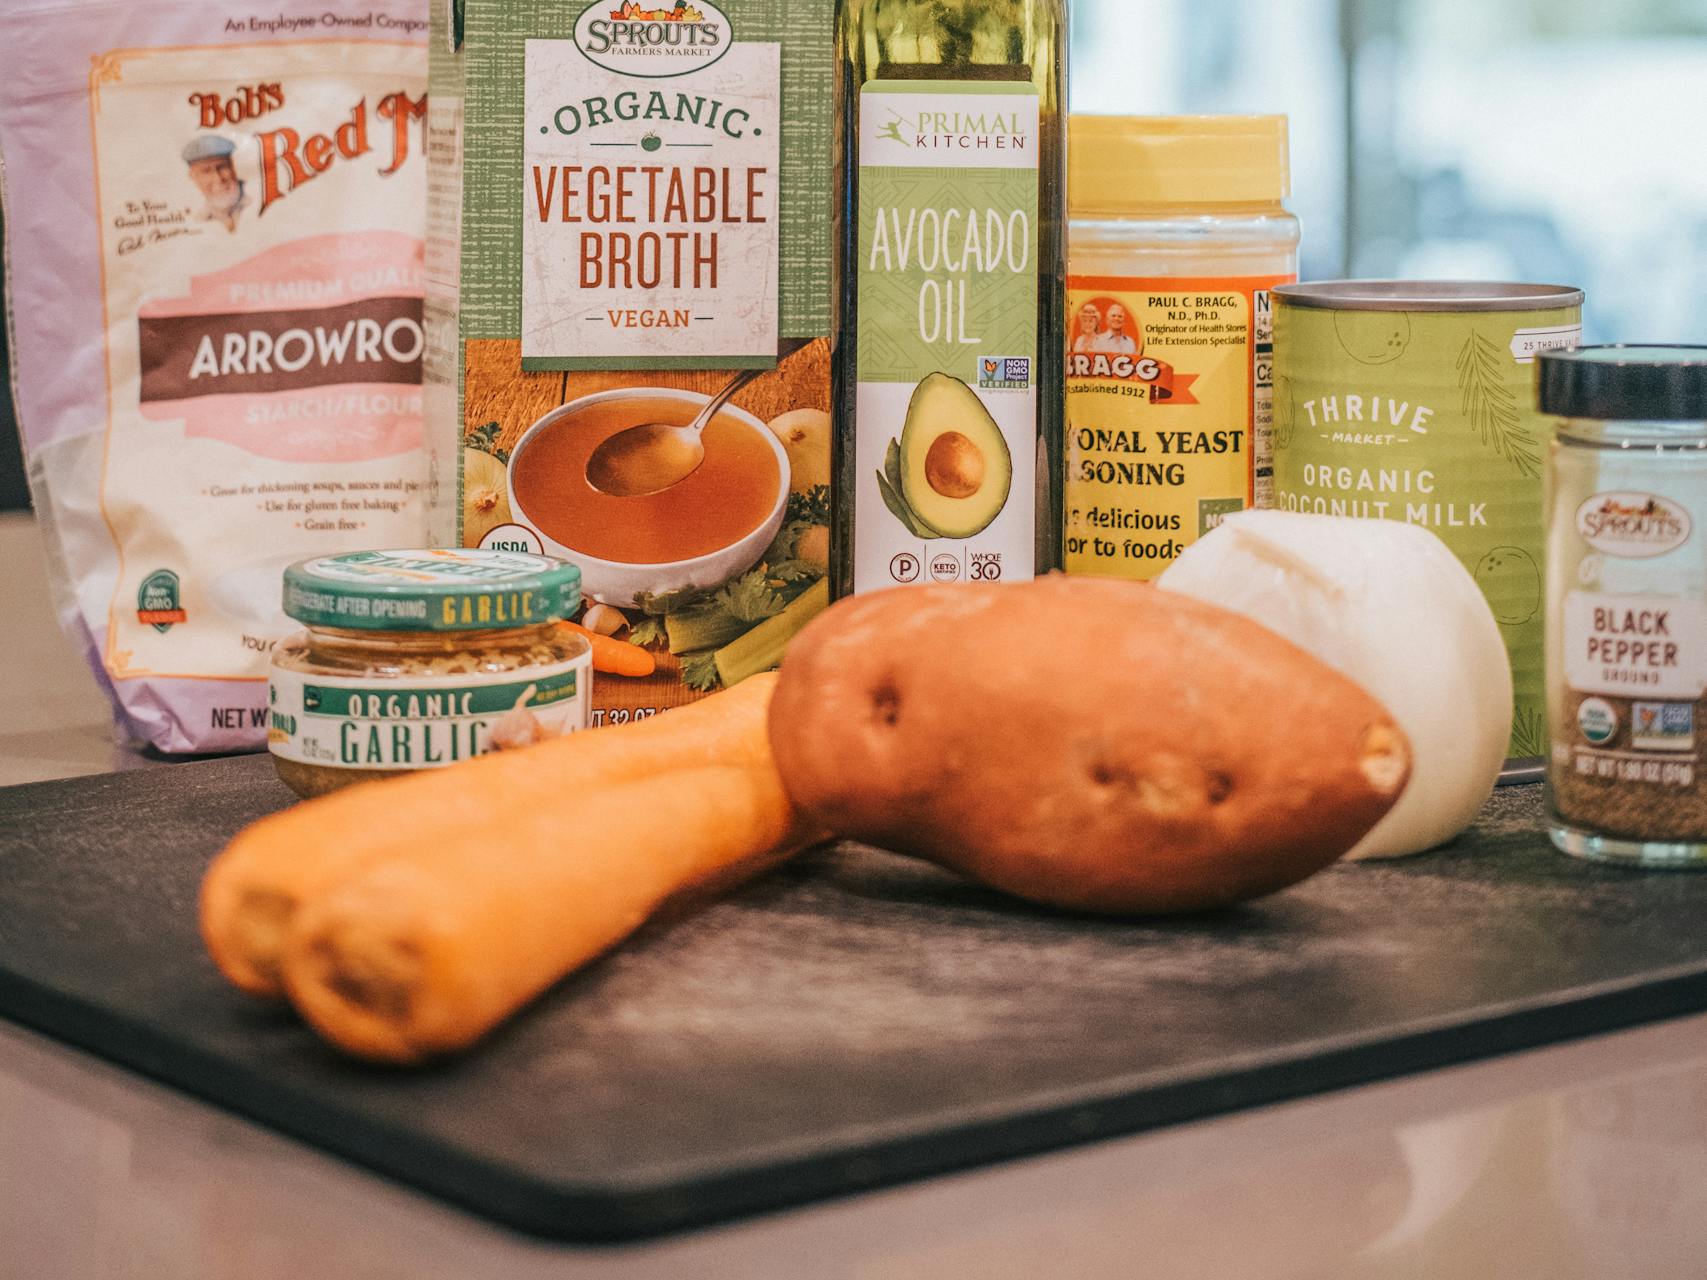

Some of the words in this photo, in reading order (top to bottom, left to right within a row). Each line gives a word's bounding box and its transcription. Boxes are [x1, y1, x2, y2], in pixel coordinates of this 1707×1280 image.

[225, 19, 246, 33] An
[586, 20, 720, 53] SPROUTS
[611, 48, 662, 56] FARMERS
[665, 48, 713, 57] MARKET
[188, 81, 286, 128] Bob's
[554, 91, 751, 139] ORGANIC
[917, 111, 1025, 135] PRIMAL
[916, 135, 1026, 149] KITCHEN
[254, 95, 373, 217] Red
[532, 165, 767, 223] VEGETABLE
[869, 208, 1029, 273] AVOCADO
[579, 231, 719, 289] BROTH
[918, 279, 982, 343] OIL
[1148, 297, 1178, 308] PAUL
[1182, 297, 1192, 308] C.
[1195, 296, 1238, 309] BRAGG,
[607, 309, 690, 328] VEGAN
[1195, 311, 1221, 320] Ph.D.
[1145, 324, 1187, 335] Originator
[1188, 324, 1197, 332] of
[1199, 324, 1224, 332] Health
[1225, 324, 1247, 332] Stores
[1147, 337, 1163, 345] Life
[1165, 337, 1208, 345] Extension
[1210, 336, 1246, 347] Specialist
[1523, 342, 1534, 351] 25
[1006, 359, 1027, 367] NON
[1121, 386, 1145, 398] 1912
[1303, 394, 1434, 434] THRIVE
[1155, 430, 1244, 454] YEAST
[1332, 432, 1395, 445] MARKET
[312, 480, 345, 493] soups,
[383, 479, 402, 491] and
[1303, 464, 1435, 494] ORGANIC
[287, 500, 302, 511] for
[305, 500, 338, 513] gluten
[341, 499, 360, 510] free
[363, 499, 399, 513] baking
[1279, 490, 1389, 521] COCONUT
[1406, 503, 1488, 527] MILK
[304, 519, 335, 531] Grain
[338, 519, 358, 531] free
[1086, 506, 1181, 530] delicious
[1582, 511, 1682, 538] SPROUTS
[970, 553, 1002, 561] WHOLE
[1092, 537, 1116, 557] to
[144, 597, 173, 610] GMO
[335, 595, 370, 616] AFTER
[371, 597, 427, 618] OPENING
[441, 591, 534, 625] GARLIC
[1593, 607, 1670, 636] BLACK
[1587, 637, 1678, 666] PEPPER
[1602, 669, 1660, 684] GROUND
[348, 691, 474, 719] ORGANIC
[211, 707, 246, 729] NET
[340, 721, 488, 764] GARLIC
